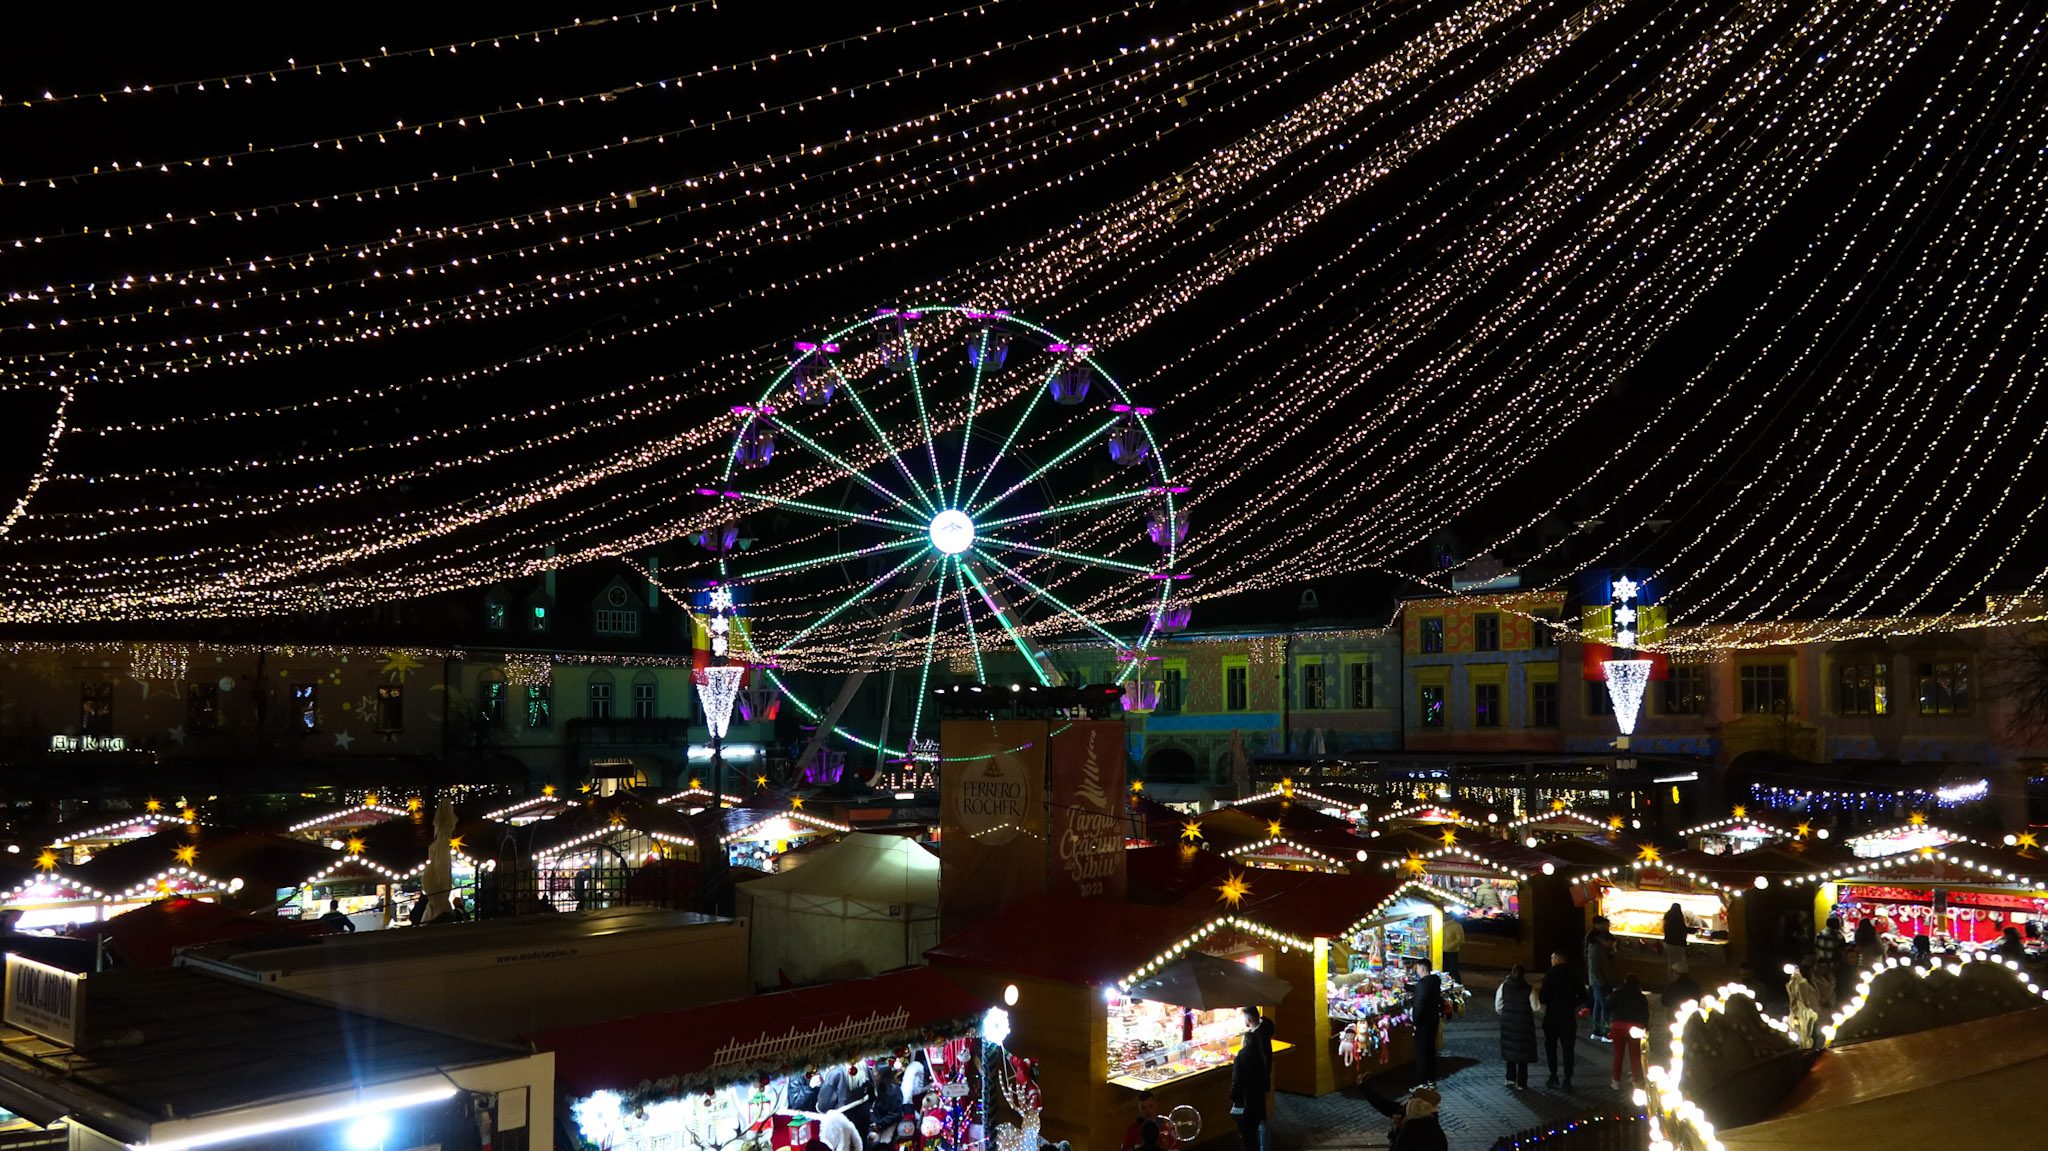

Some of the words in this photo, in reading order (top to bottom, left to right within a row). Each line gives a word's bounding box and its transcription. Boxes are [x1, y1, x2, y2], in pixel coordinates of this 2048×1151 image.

[964, 781, 1020, 798] FERRERO
[964, 798, 1021, 816] ROCHER
[1066, 804, 1115, 837] Târgul
[1060, 829, 1122, 859] Crăciun
[1080, 881, 1104, 896] 2023
